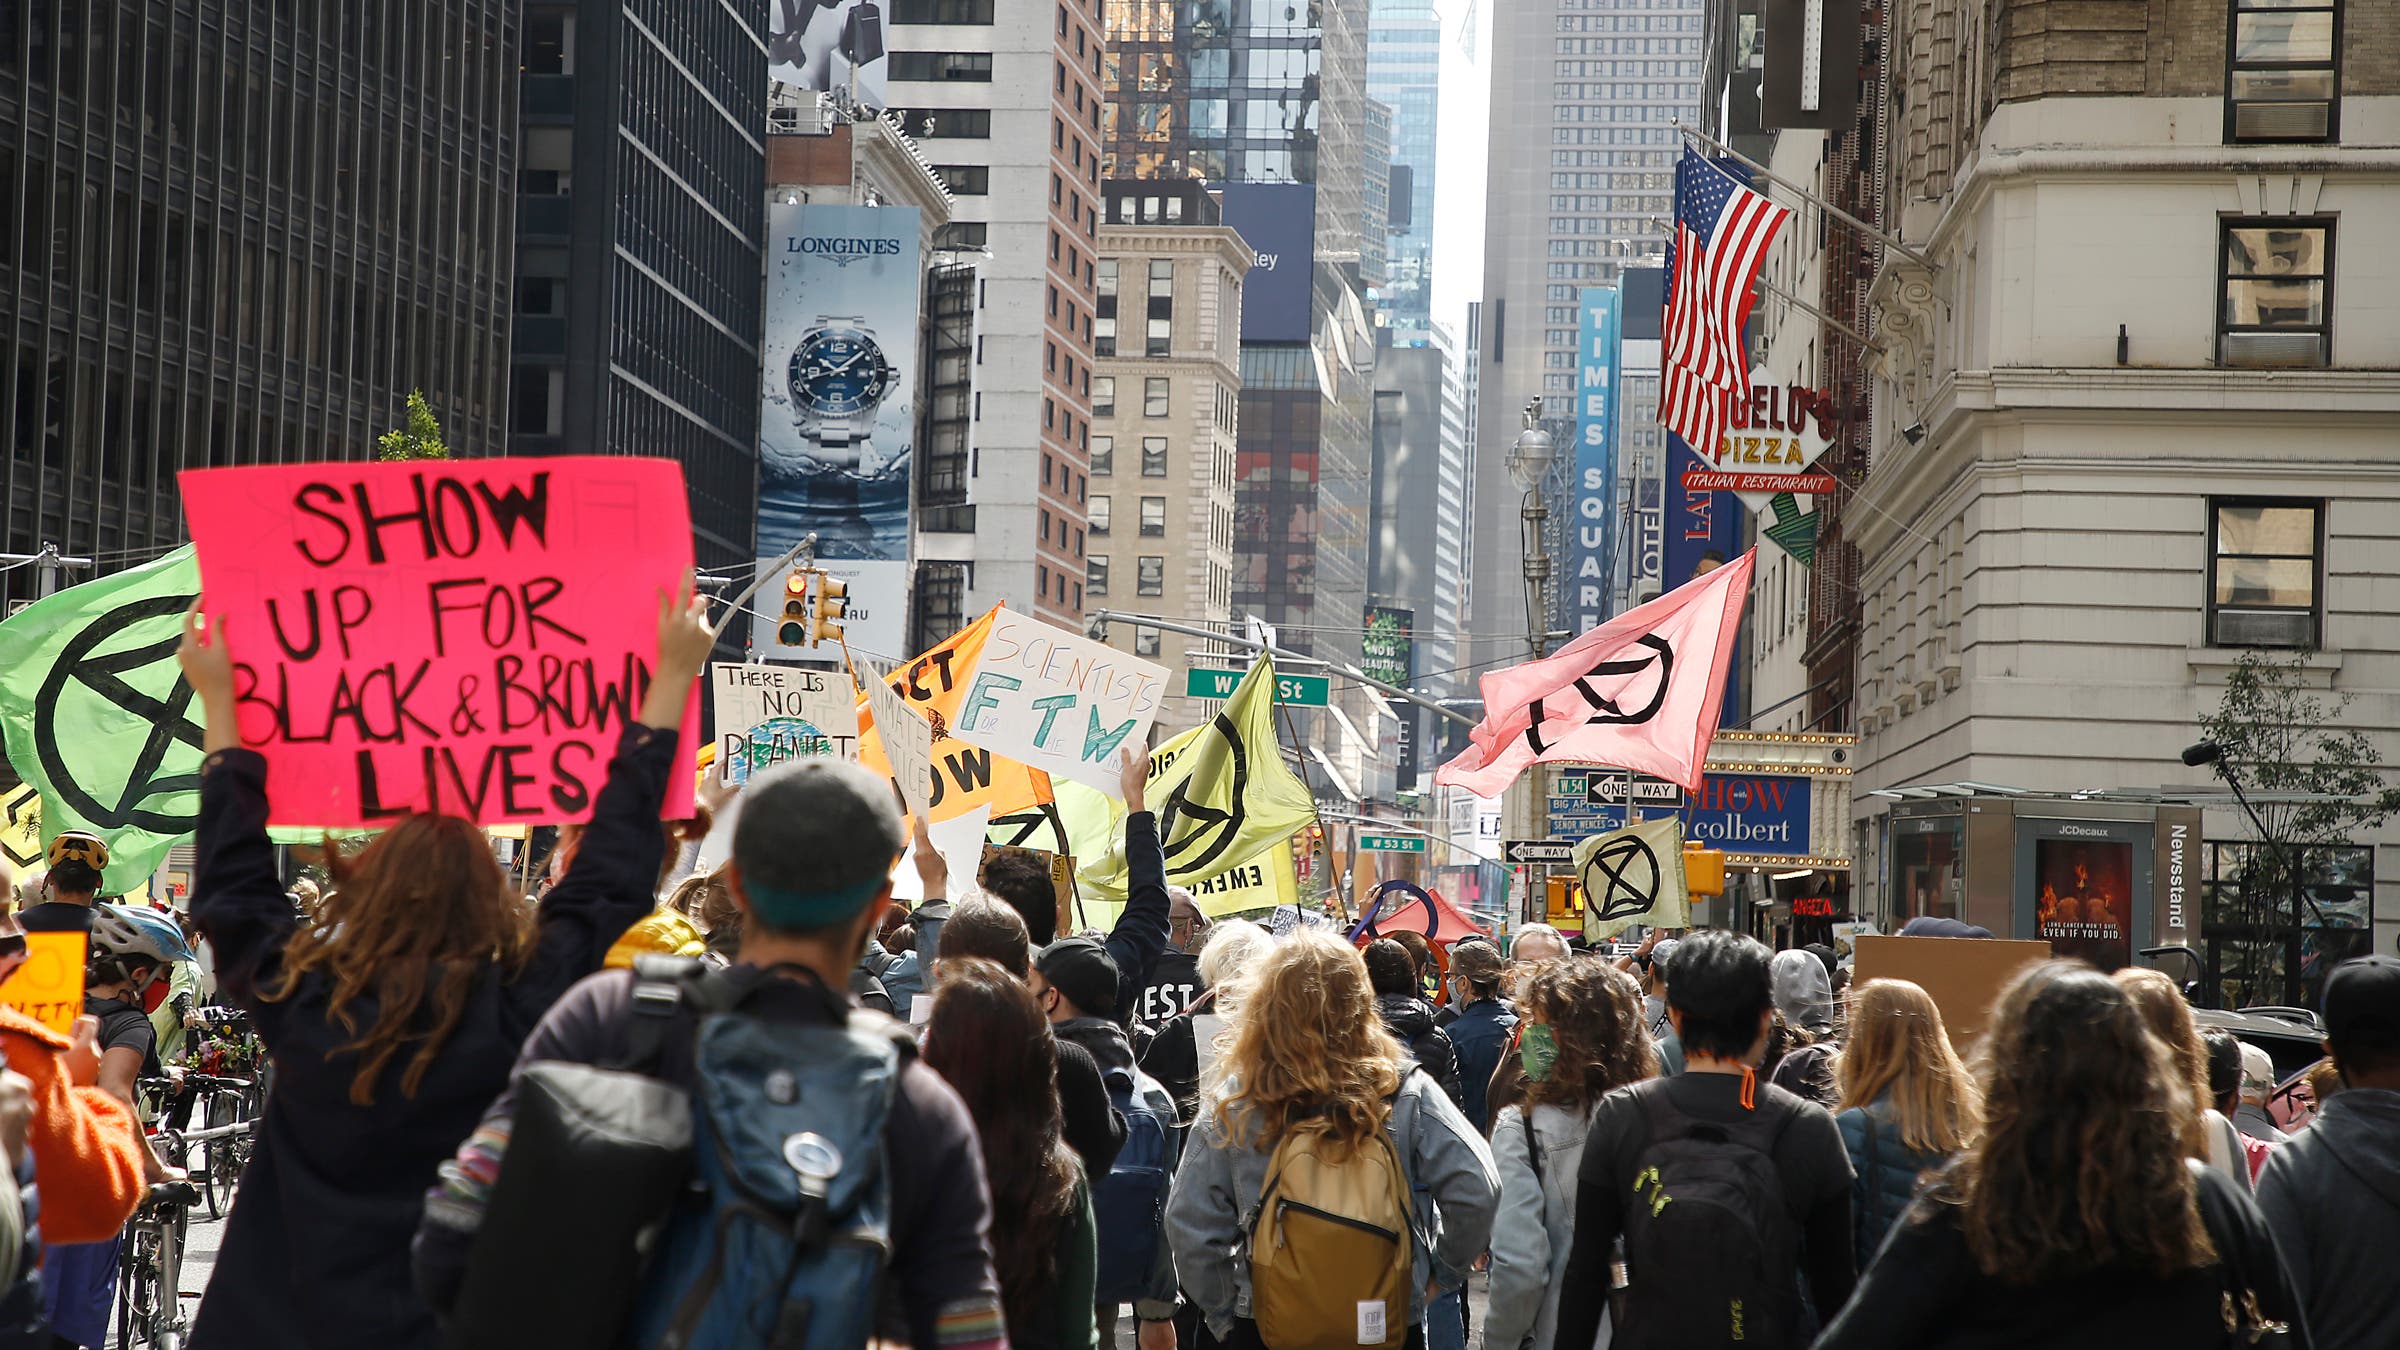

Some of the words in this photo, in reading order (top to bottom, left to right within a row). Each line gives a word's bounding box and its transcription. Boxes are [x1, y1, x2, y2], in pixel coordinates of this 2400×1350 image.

[787, 237, 900, 255] LONGINES
[1584, 308, 1608, 446] TIMES
[1721, 437, 1804, 465] PIZZA
[1686, 474, 1736, 488] ITALIAN
[1741, 475, 1828, 490] RESTAURANT
[293, 472, 550, 568] SHOW
[267, 585, 372, 661] UP
[428, 576, 587, 657] FOR
[717, 665, 785, 688] THERE
[989, 624, 1160, 715] SCIENTISTS
[1214, 675, 1232, 694] W
[1279, 680, 1303, 699] St
[232, 659, 440, 747] BLACK
[450, 674, 485, 738] &
[762, 691, 804, 716] NO
[355, 739, 595, 823] LIVES
[1560, 779, 1568, 793] W
[1571, 779, 1583, 793] 54
[1602, 783, 1627, 796] ONE
[1642, 784, 1671, 797] WAY
[1553, 799, 1569, 809] BIG
[1694, 813, 1790, 842] colbert
[2059, 825, 2108, 838] JCDecaux
[1372, 839, 1382, 848] W
[1384, 840, 1398, 849] 53
[1402, 840, 1414, 849] St
[1515, 847, 1534, 857] ONE
[1544, 847, 1566, 857] WAY
[2169, 825, 2188, 928] Newsstand
[2043, 928, 2066, 937] EVEN
[2069, 929, 2078, 938] IF
[2082, 929, 2099, 939] YOU
[2103, 930, 2122, 940] DID.
